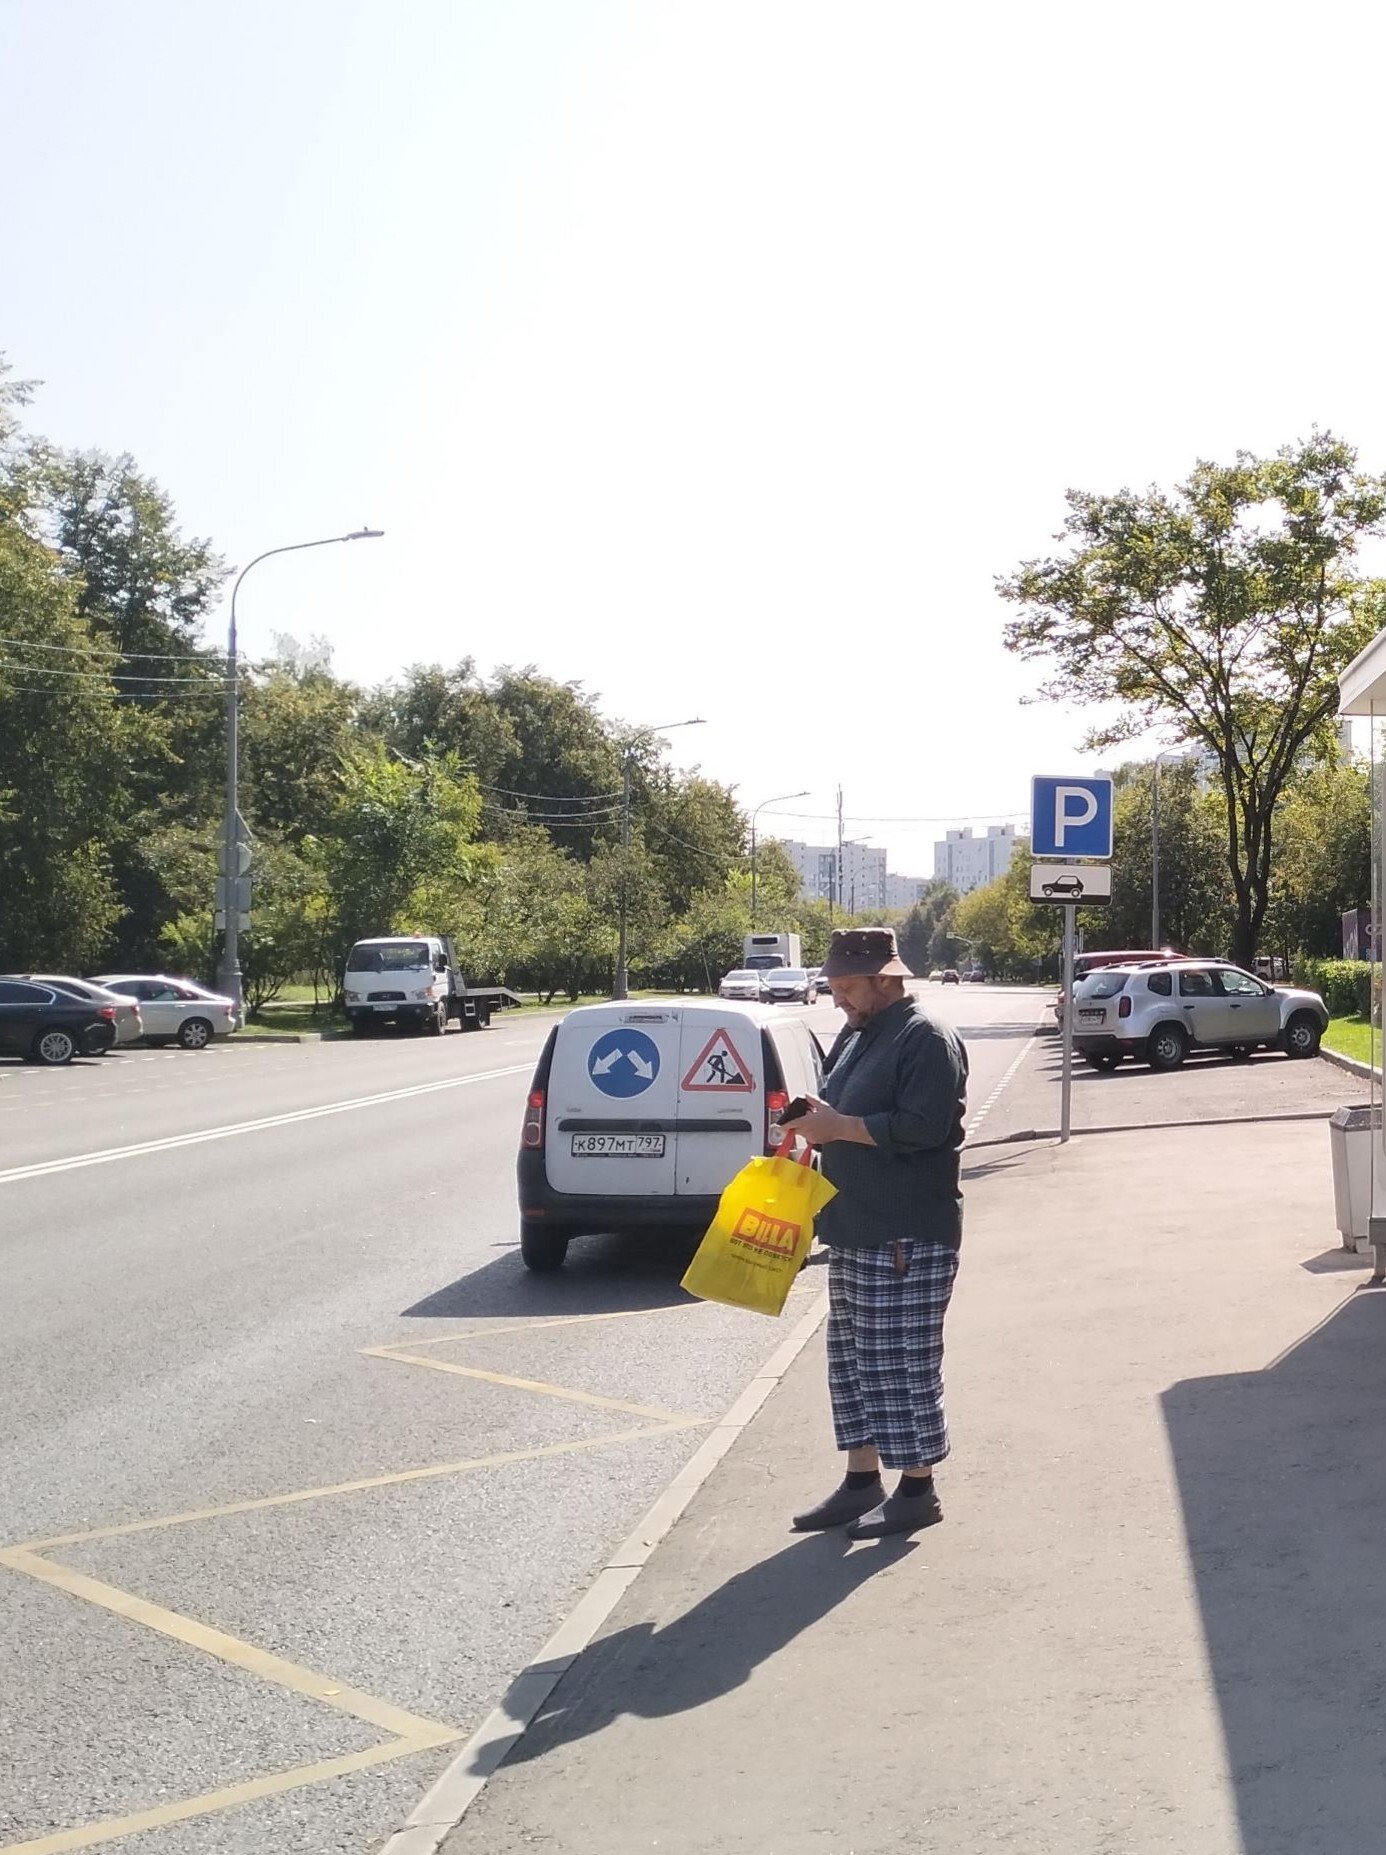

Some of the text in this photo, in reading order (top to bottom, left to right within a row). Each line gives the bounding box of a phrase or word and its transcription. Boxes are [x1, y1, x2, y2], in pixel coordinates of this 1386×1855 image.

[1055, 786, 1098, 847] P
[638, 1137, 660, 1148] 797
[738, 1214, 794, 1251] BILLA
